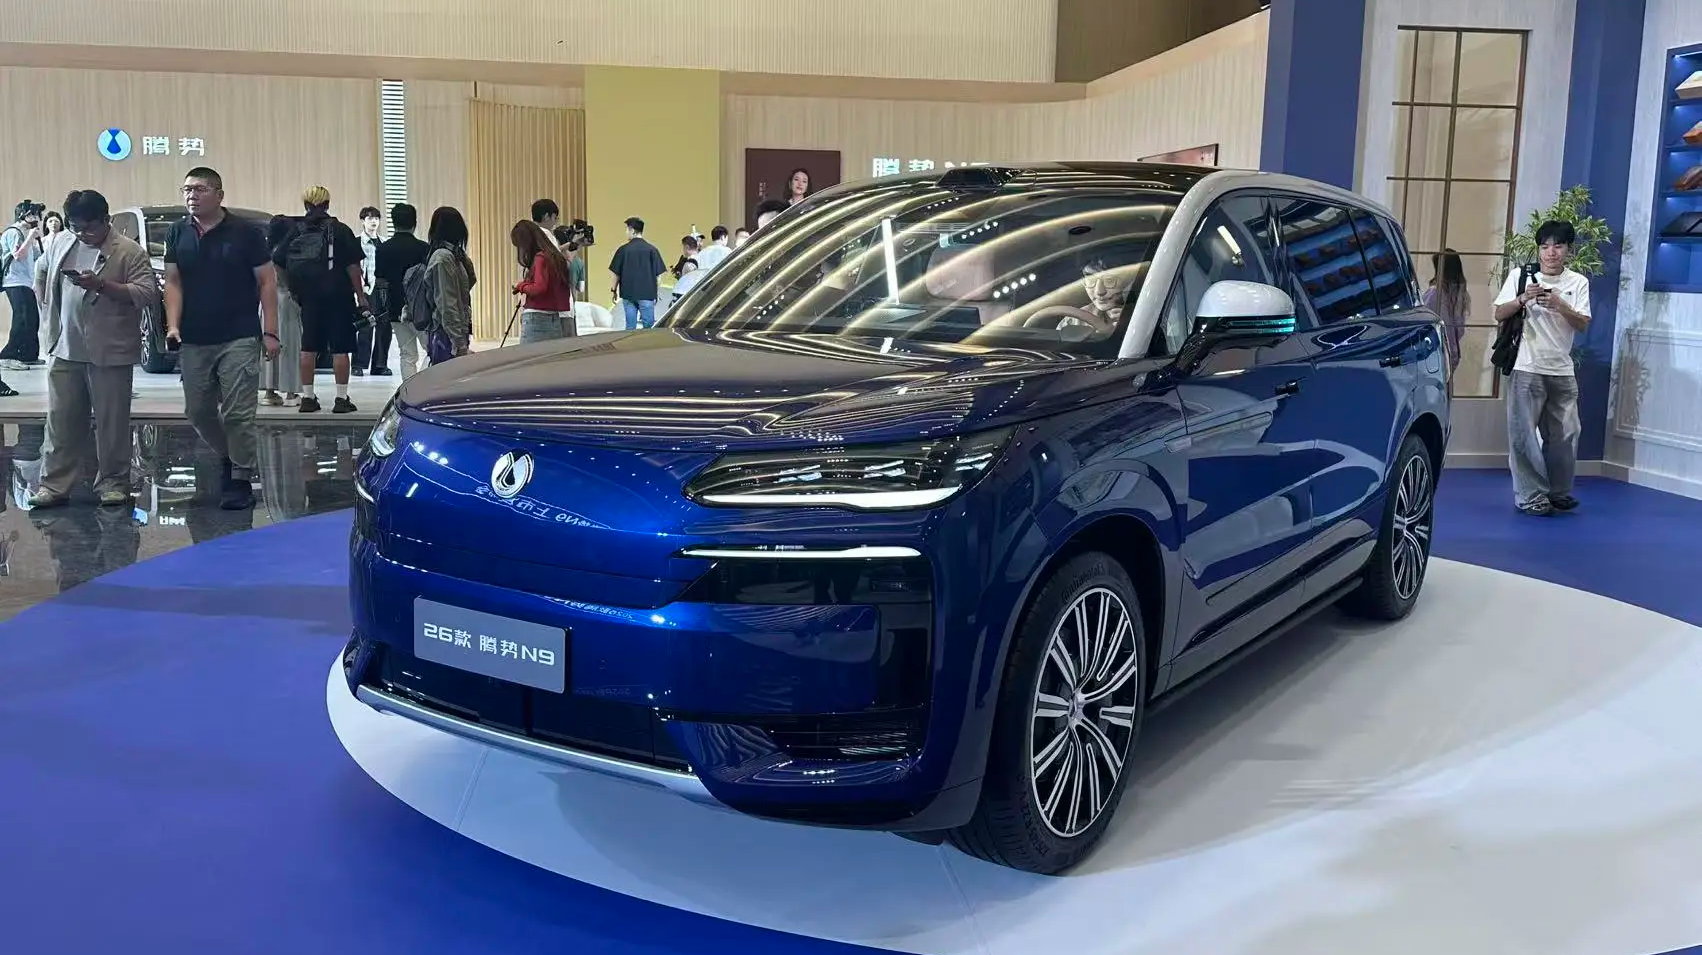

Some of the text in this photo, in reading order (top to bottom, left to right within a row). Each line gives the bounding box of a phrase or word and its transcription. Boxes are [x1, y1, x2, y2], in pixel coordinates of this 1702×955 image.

[142, 136, 205, 156] 腾势
[423, 622, 555, 666] 26款 腾势N9
